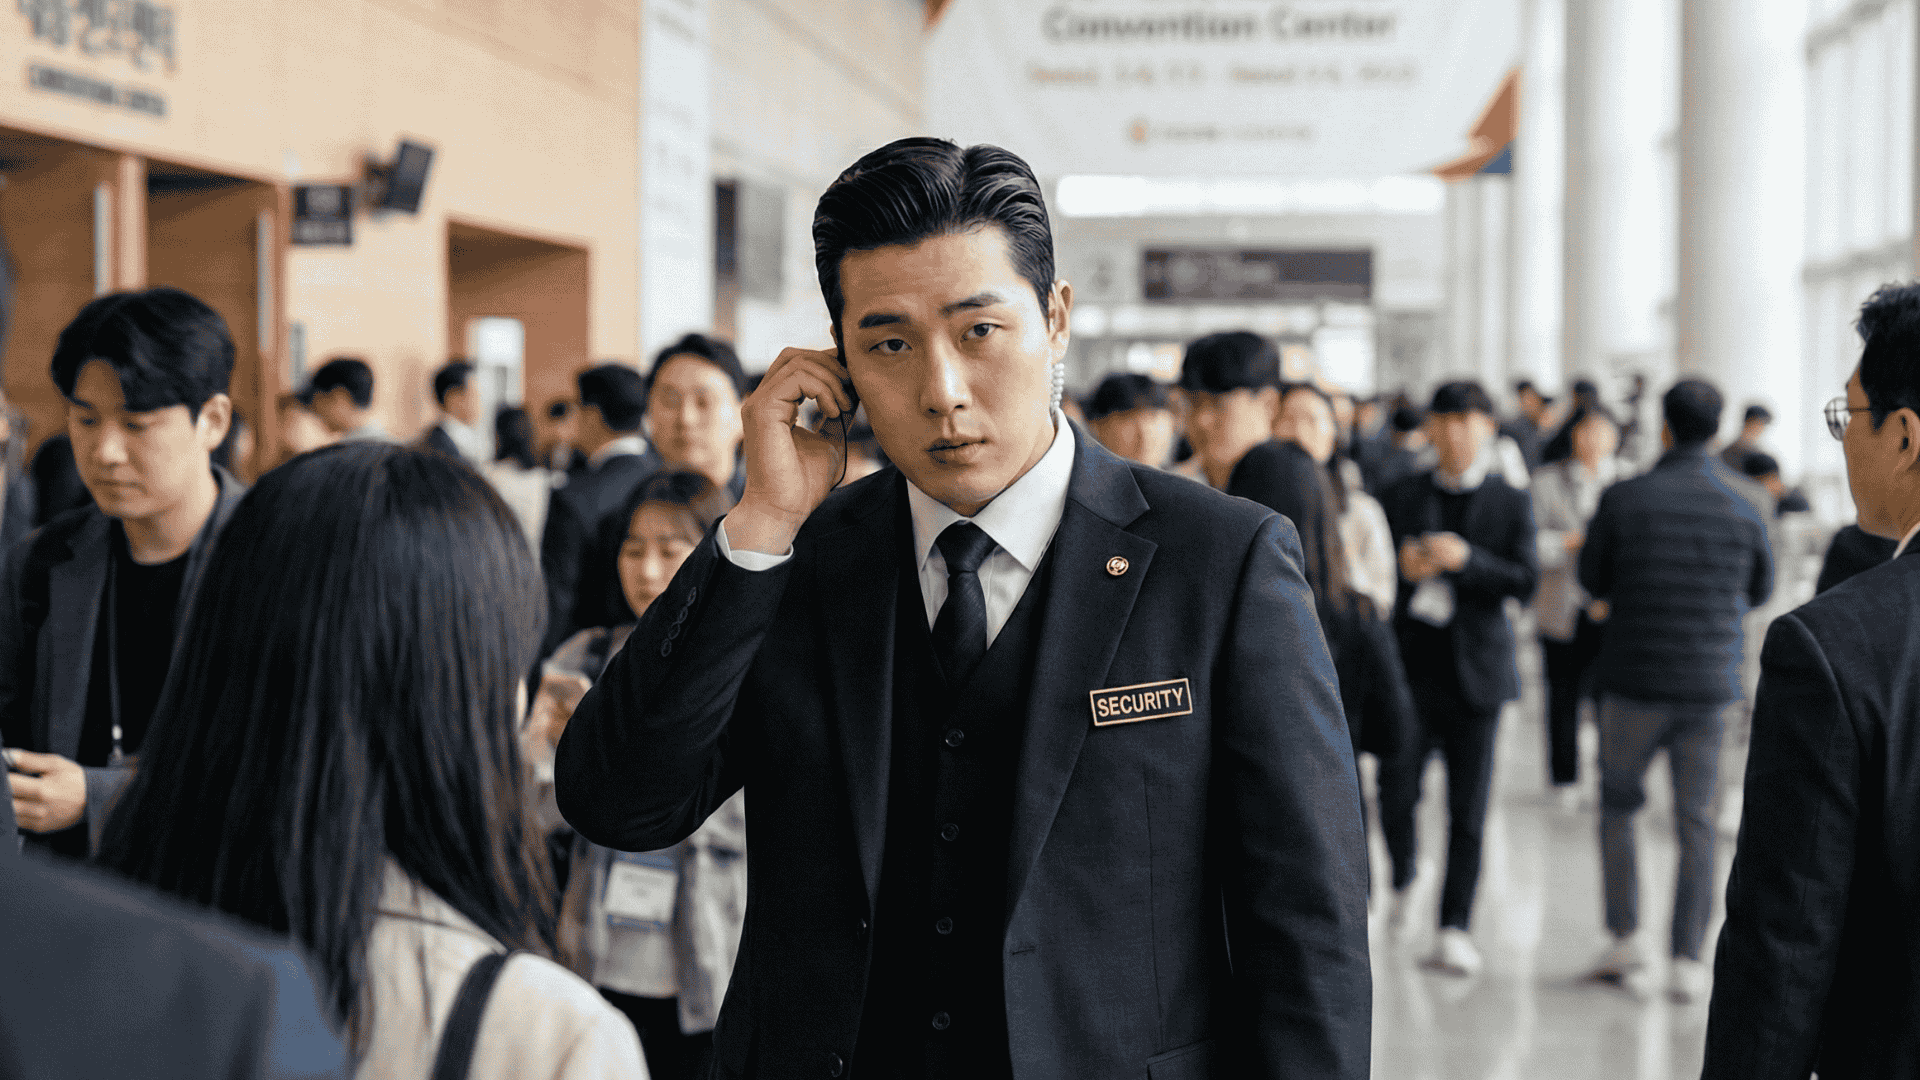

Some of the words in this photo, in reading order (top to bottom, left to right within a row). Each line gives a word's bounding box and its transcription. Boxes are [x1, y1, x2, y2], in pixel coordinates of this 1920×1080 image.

[1044, 8, 1256, 41] Convention
[1270, 8, 1395, 40] Center
[1097, 687, 1183, 717] SECURITY
